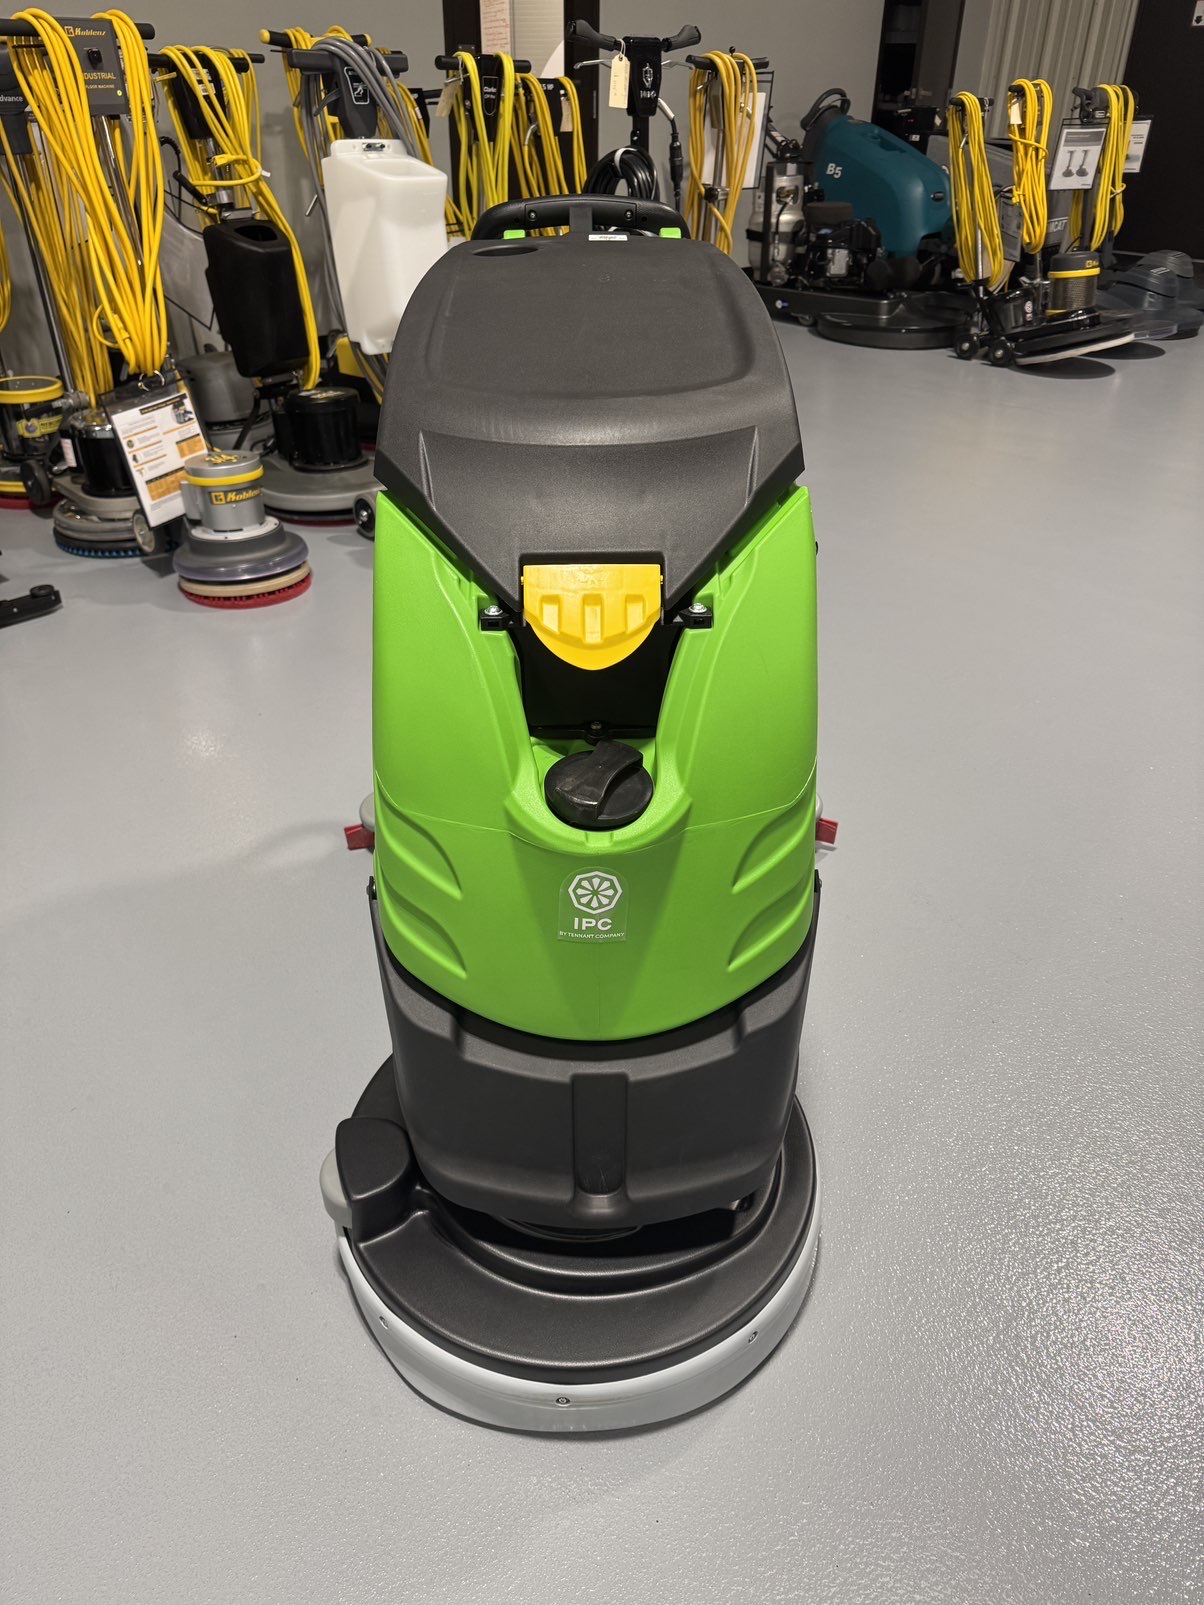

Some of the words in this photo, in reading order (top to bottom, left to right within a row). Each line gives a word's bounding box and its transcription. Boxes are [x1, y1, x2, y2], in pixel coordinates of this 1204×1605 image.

[75, 27, 107, 36] Koblenz
[84, 72, 117, 80] DUSTRIAL
[0, 94, 24, 102] dvance
[826, 162, 843, 179] B5
[573, 917, 613, 931] IPC
